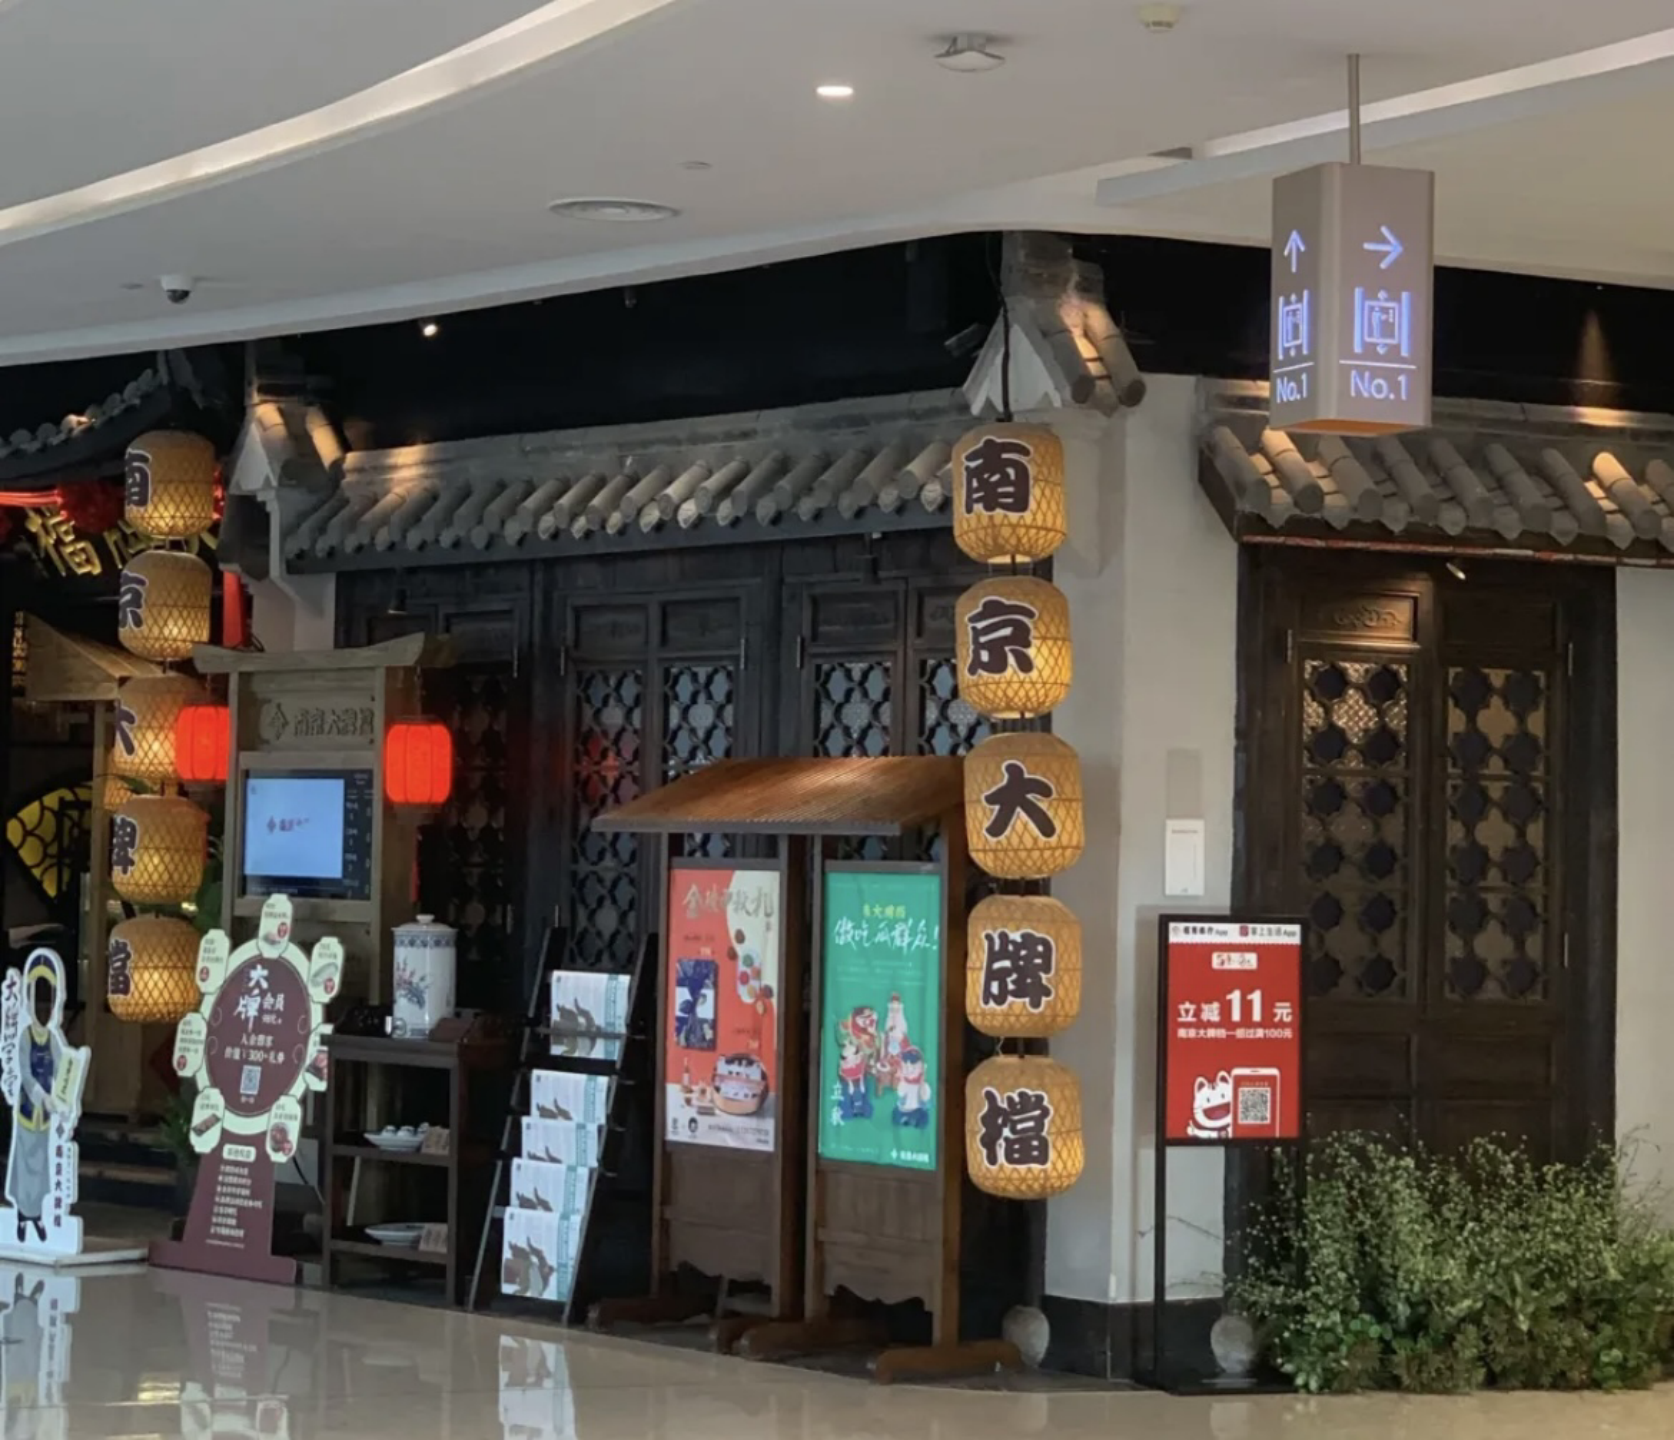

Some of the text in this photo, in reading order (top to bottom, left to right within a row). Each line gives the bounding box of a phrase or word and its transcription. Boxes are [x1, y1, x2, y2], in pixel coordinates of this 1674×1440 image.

[1276, 372, 1308, 403] No.1
[1350, 369, 1409, 401] No.1
[1176, 988, 1294, 1022] 立减11元
